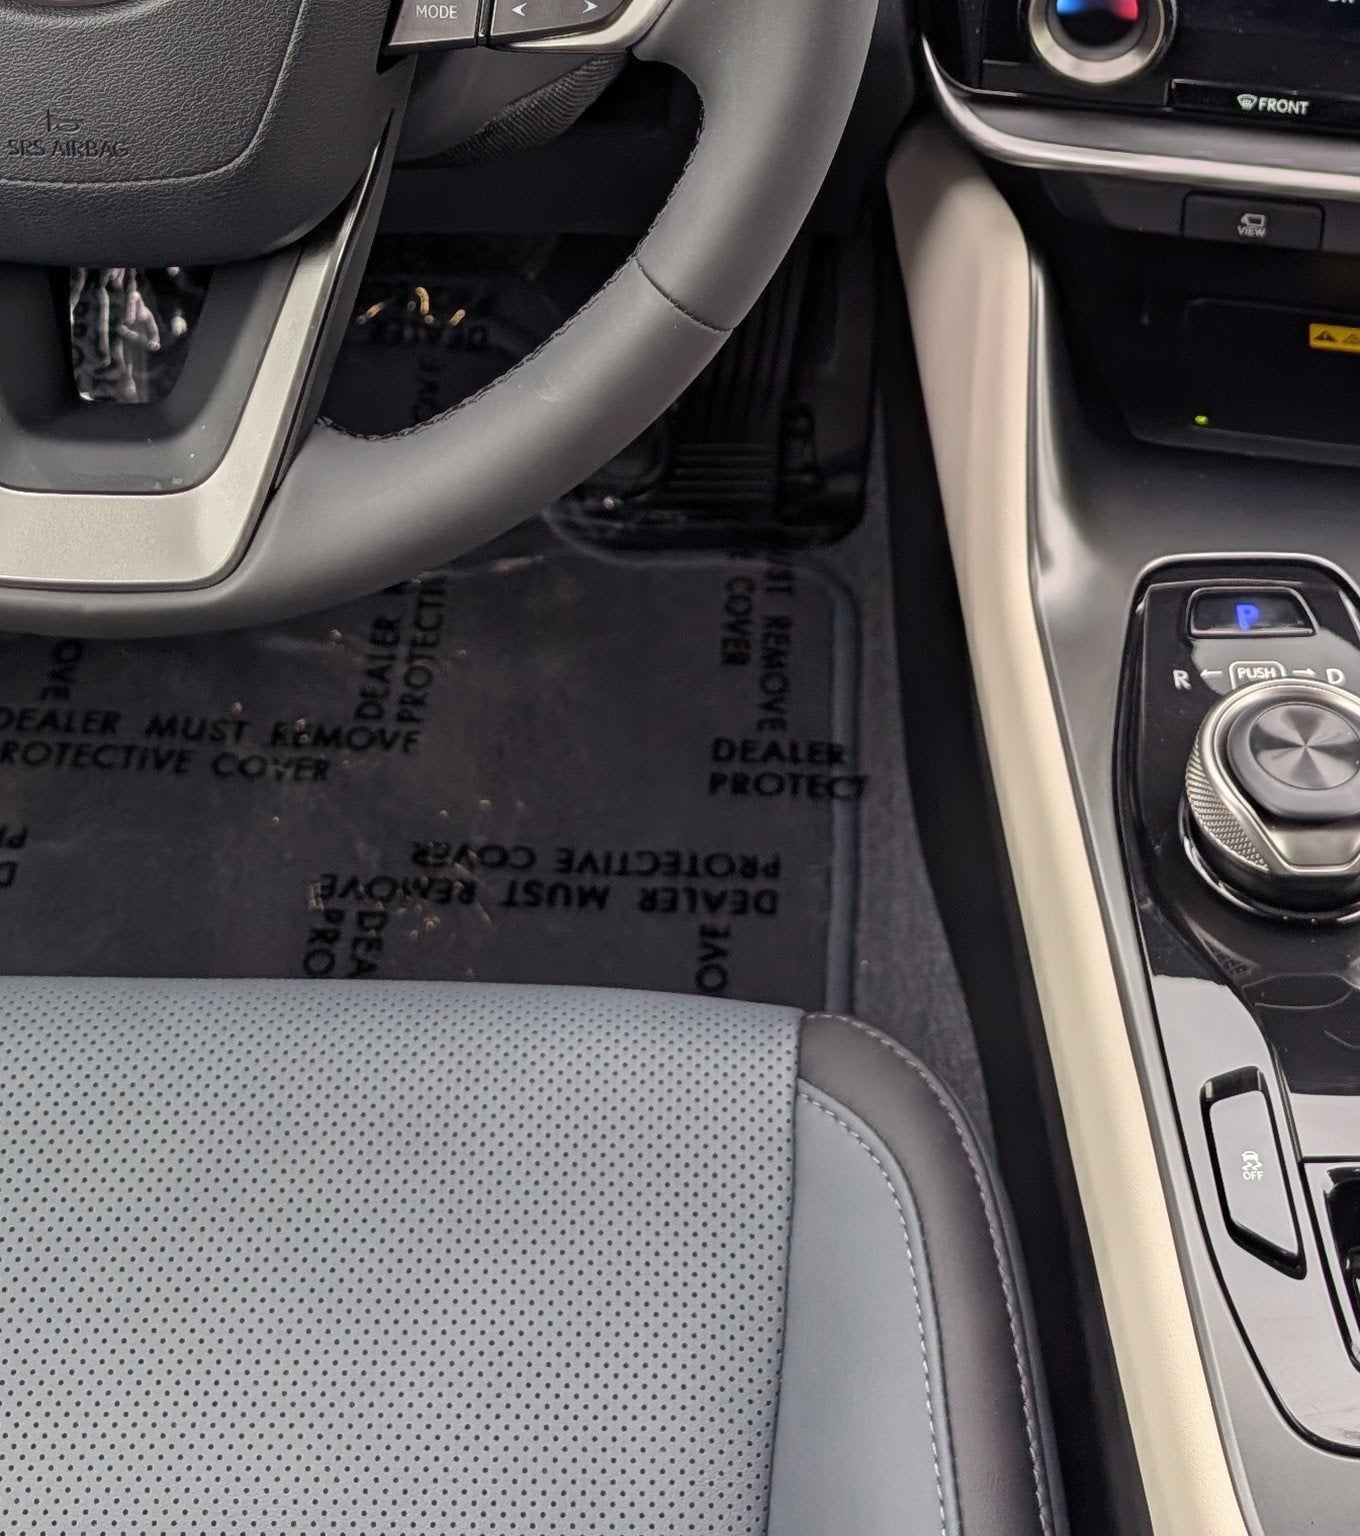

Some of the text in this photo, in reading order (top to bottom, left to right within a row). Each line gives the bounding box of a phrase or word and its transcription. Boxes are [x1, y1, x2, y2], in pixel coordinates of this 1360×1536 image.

[416, 5, 458, 20] MODE
[1259, 97, 1310, 116] FRONT
[7, 139, 130, 158] SRS AIRBAG
[721, 575, 756, 667] COVER
[1236, 604, 1260, 630] P
[353, 614, 404, 723] DEALER
[758, 613, 793, 733] REMOVE
[1173, 669, 1191, 690] R
[1238, 666, 1276, 681] PUSH
[1327, 668, 1344, 686] D
[144, 713, 250, 746] MUST
[264, 720, 423, 755] REMOVE
[710, 737, 850, 767] DEALER
[210, 752, 332, 783] COVER
[555, 846, 782, 881] PROTECTIVE
[319, 871, 781, 918] DEALER MUST REMOVE
[1242, 1169, 1264, 1181] OFF
